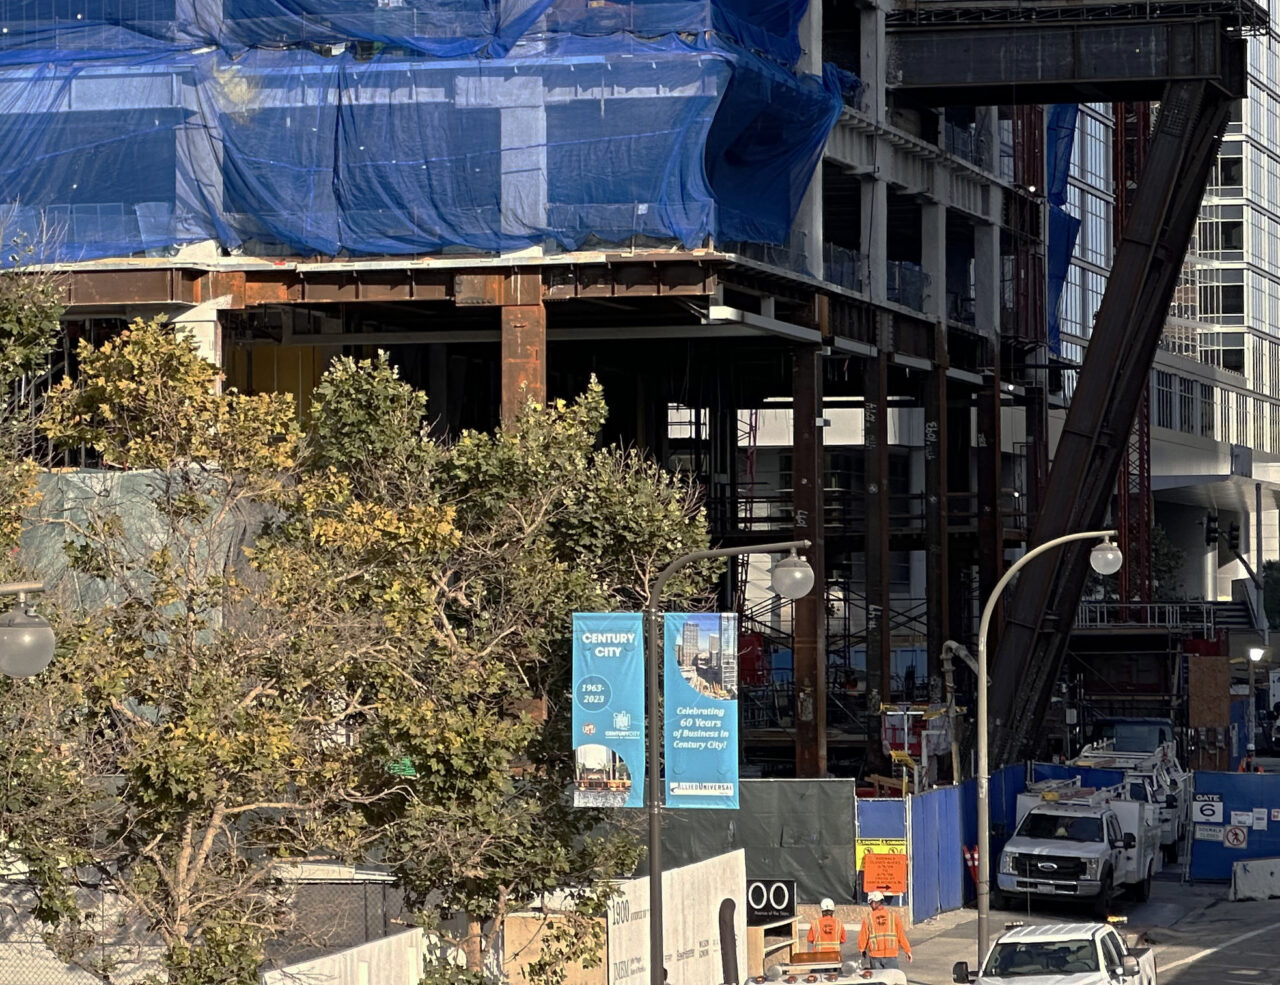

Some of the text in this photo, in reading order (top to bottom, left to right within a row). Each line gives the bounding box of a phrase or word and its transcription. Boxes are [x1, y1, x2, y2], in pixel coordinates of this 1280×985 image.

[582, 632, 636, 644] CENTURY
[594, 647, 622, 657] CITY
[581, 683, 605, 693] 1963-
[583, 695, 605, 704] 2023
[676, 706, 725, 718] Celebrating
[680, 718, 722, 728] 60 Years
[673, 730, 729, 739] of Business in
[673, 740, 727, 750] Century City!
[1199, 803, 1216, 817] 6
